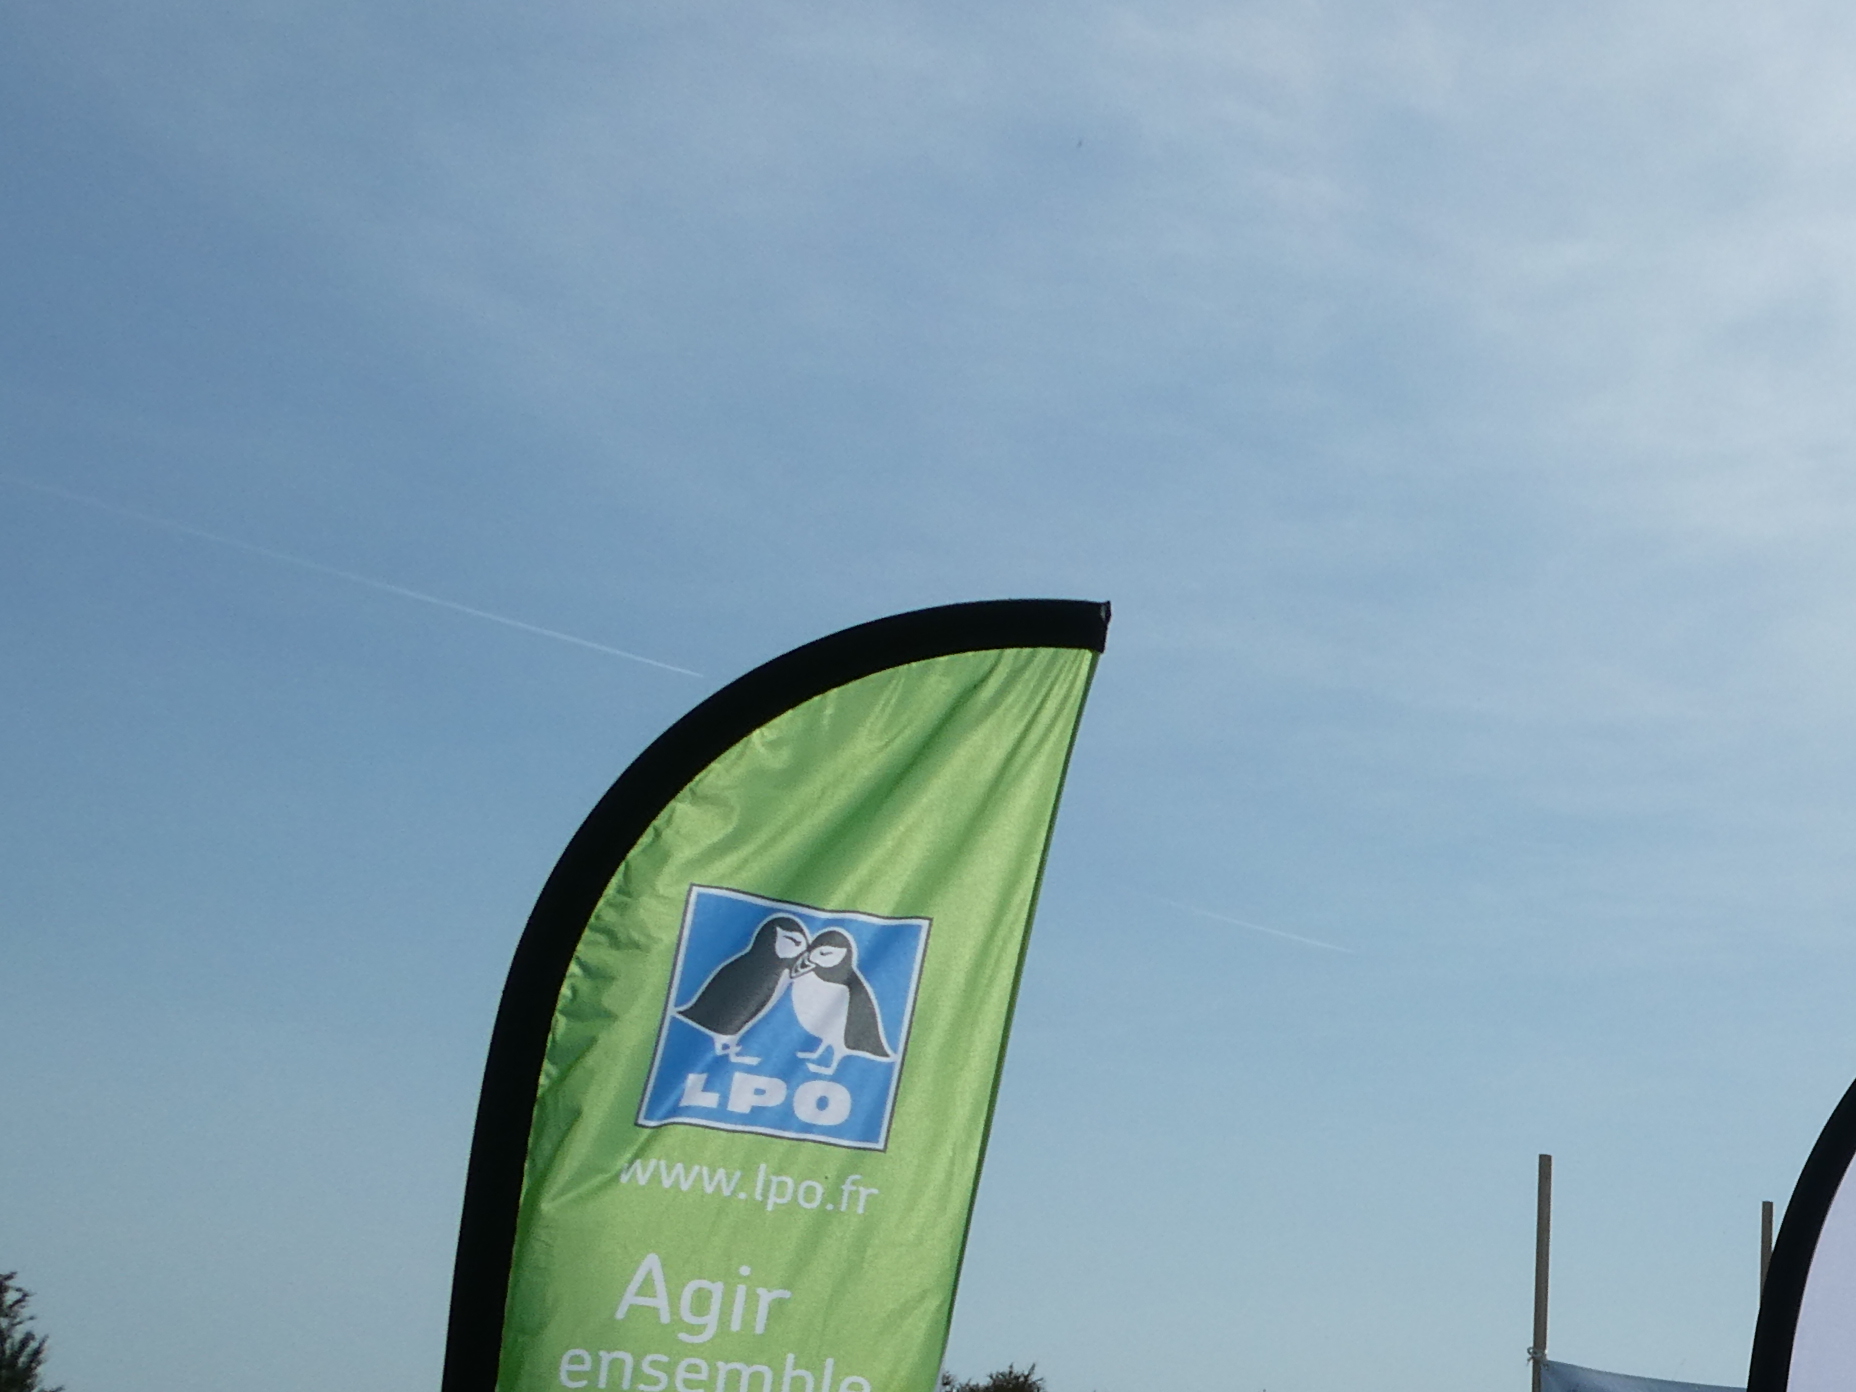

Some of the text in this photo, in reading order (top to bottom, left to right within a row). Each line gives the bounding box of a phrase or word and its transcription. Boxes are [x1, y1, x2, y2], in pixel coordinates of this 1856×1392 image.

[678, 1071, 853, 1126] LPO
[619, 1158, 880, 1214] www.lpo.fr
[614, 1252, 792, 1344] Agir
